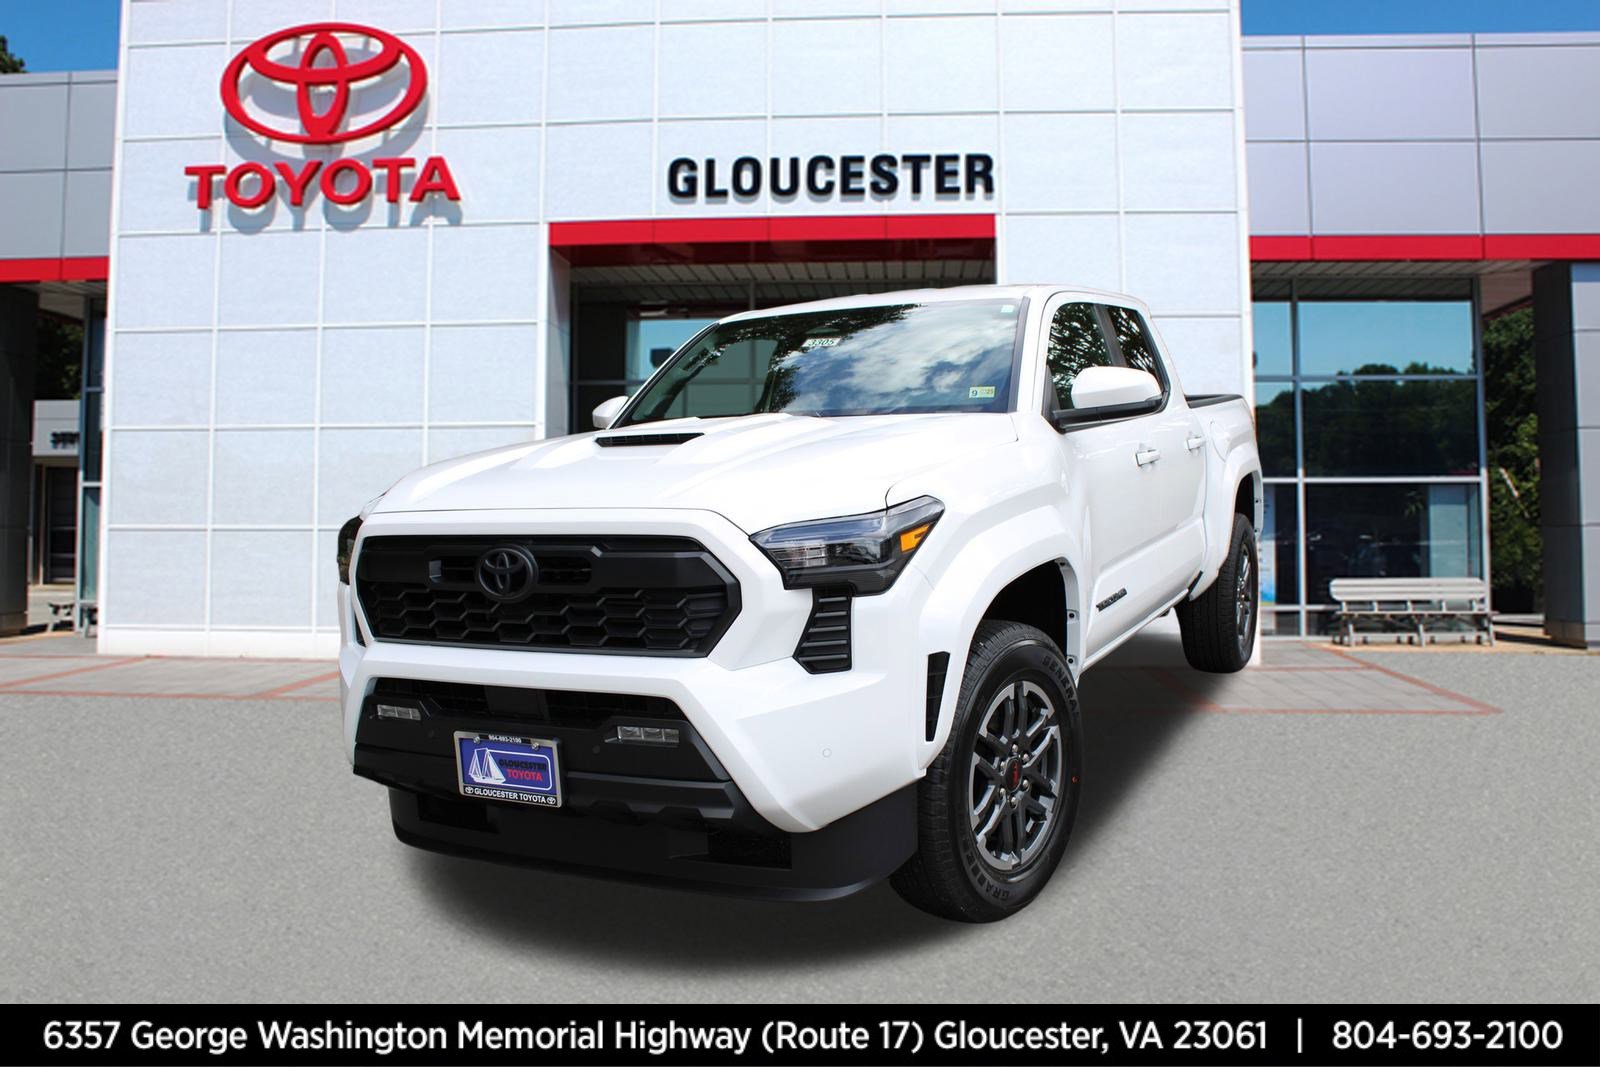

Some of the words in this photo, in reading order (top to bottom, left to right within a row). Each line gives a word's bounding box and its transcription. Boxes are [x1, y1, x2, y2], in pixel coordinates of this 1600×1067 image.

[184, 156, 463, 210] TOYOTA
[668, 153, 994, 199] GLOUCESTER
[498, 759, 547, 771] GLOUCESTER
[507, 768, 543, 781] TOYOTA
[474, 788, 518, 800] GLOUCESTER
[519, 793, 547, 804] TOYOTA
